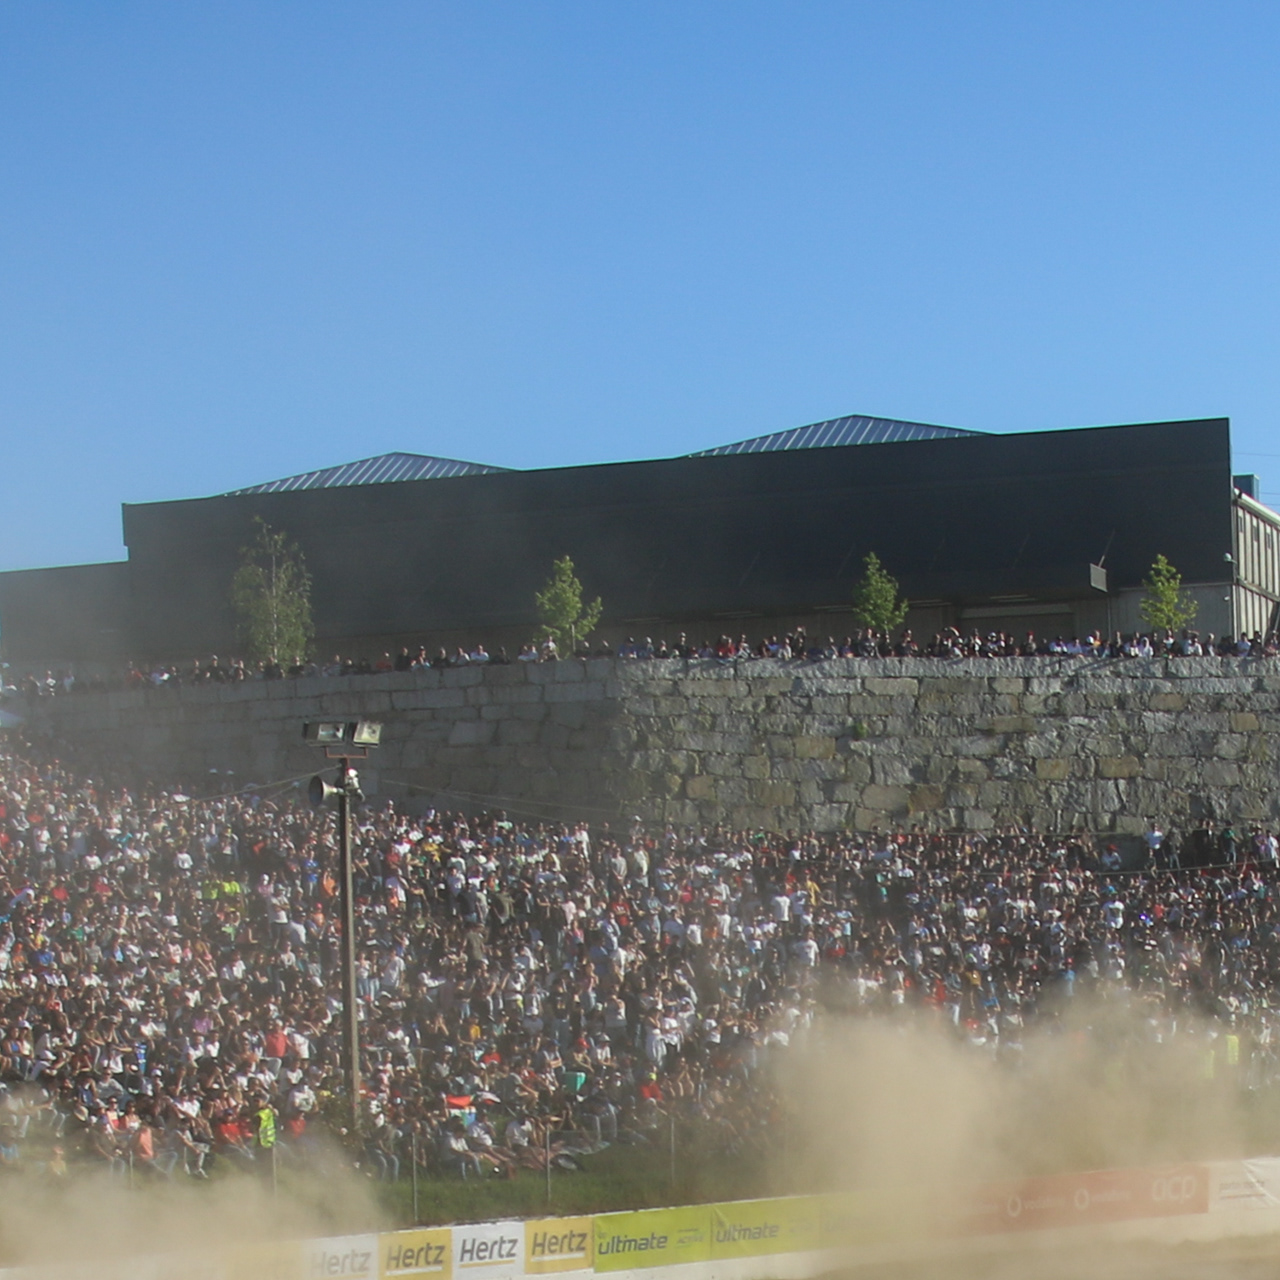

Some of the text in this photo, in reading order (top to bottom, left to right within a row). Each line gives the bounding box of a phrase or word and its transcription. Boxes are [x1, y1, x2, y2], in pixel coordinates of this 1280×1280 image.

[1152, 1175, 1197, 1204] acp
[531, 1230, 588, 1256] Hertz
[598, 1232, 668, 1256] ultimate
[715, 1222, 780, 1244] ultimate
[311, 1249, 370, 1275] Hertz
[385, 1243, 445, 1269] Hertz
[460, 1236, 518, 1263] Hertz
